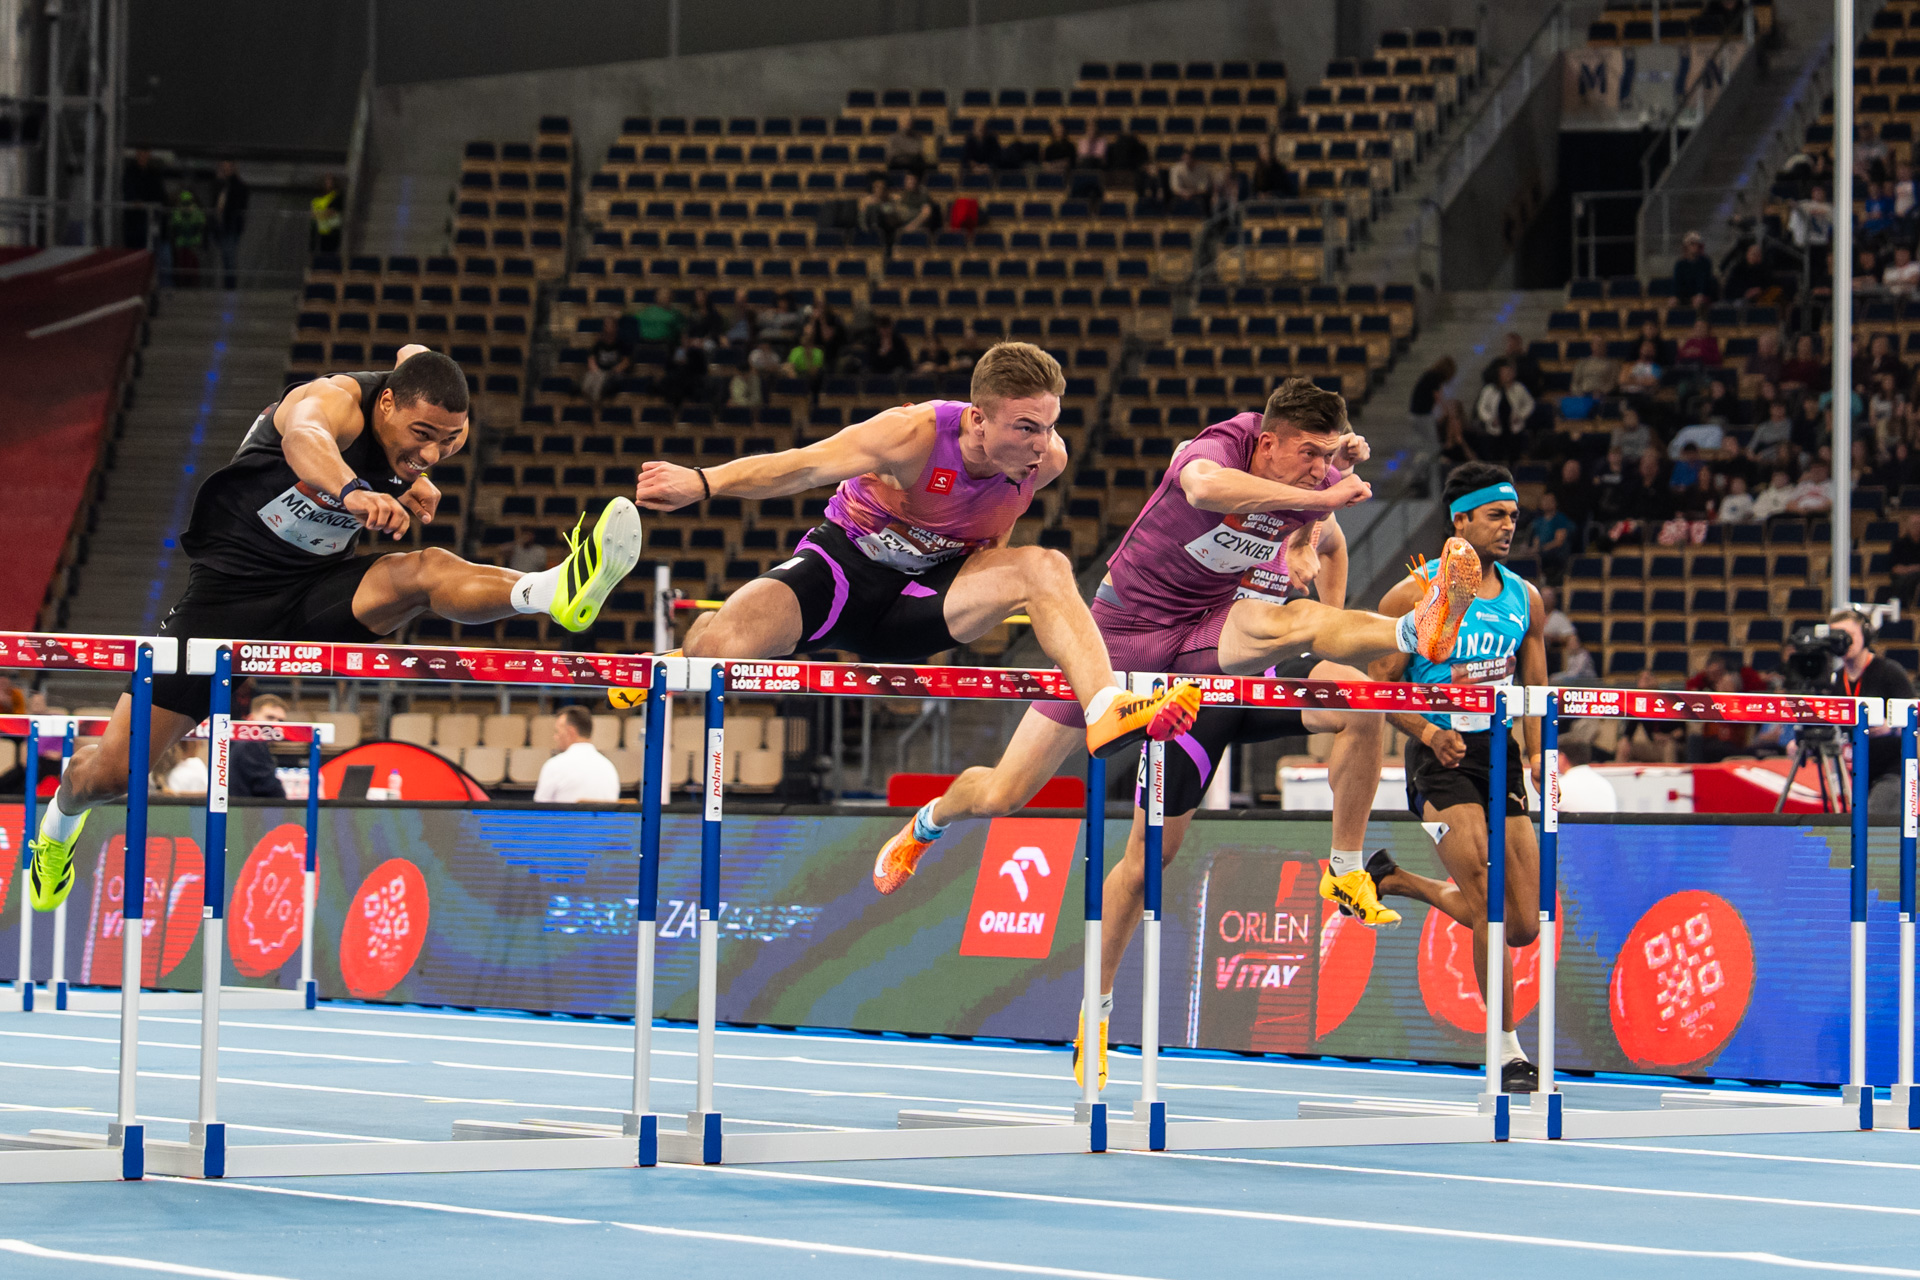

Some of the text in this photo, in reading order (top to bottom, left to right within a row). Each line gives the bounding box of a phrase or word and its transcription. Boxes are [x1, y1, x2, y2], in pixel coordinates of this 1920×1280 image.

[1268, 516, 1285, 527] CUP
[1257, 523, 1280, 536] 2026
[1213, 531, 1275, 561] CZYKIER
[1253, 569, 1280, 582] ORLEN
[240, 645, 323, 660] ORLEN CUP
[1456, 632, 1517, 659] INDIA
[240, 659, 323, 673] ŁÓDŹ 2026
[730, 664, 800, 678] ORLEN CUP
[1466, 659, 1494, 672] ORLEN
[732, 677, 800, 691] ŁÓDŹ 2026
[1213, 678, 1235, 690] CUP
[1203, 692, 1235, 703] 2026
[1563, 691, 1620, 703] ORLEN CUP
[1564, 702, 1620, 715] ŁÓDŹ 2026
[238, 726, 285, 741] 2026
[217, 737, 228, 788] polanik
[712, 751, 722, 798] polanik
[1153, 760, 1163, 803] polanik
[1549, 770, 1558, 812] polanik
[1908, 778, 1918, 818] polanik
[107, 875, 165, 903] OEN
[979, 910, 1045, 934] ORLEN
[1218, 910, 1309, 944] ORLEN
